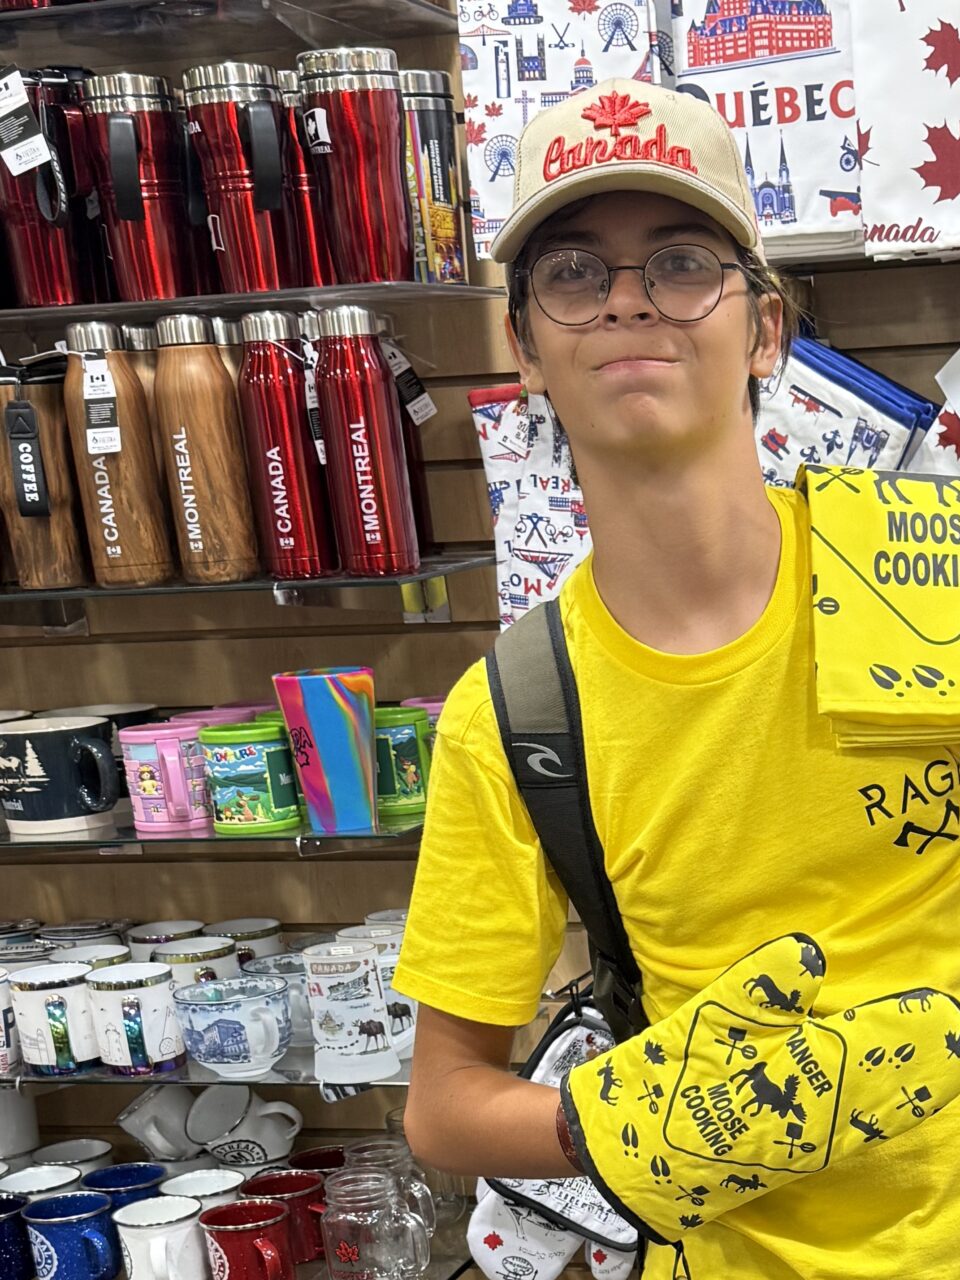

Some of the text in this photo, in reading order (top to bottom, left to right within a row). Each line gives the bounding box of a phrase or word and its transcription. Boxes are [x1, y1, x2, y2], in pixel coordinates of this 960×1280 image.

[543, 124, 698, 182] Canada
[18, 442, 39, 503] COFFEE
[92, 456, 119, 542] CANADA
[173, 427, 202, 545] MONTREAL
[266, 446, 293, 533] CANADA
[350, 416, 381, 531] MONTREAL
[679, 1084, 735, 1157] COOKING
[707, 1082, 750, 1141] MOOSE
